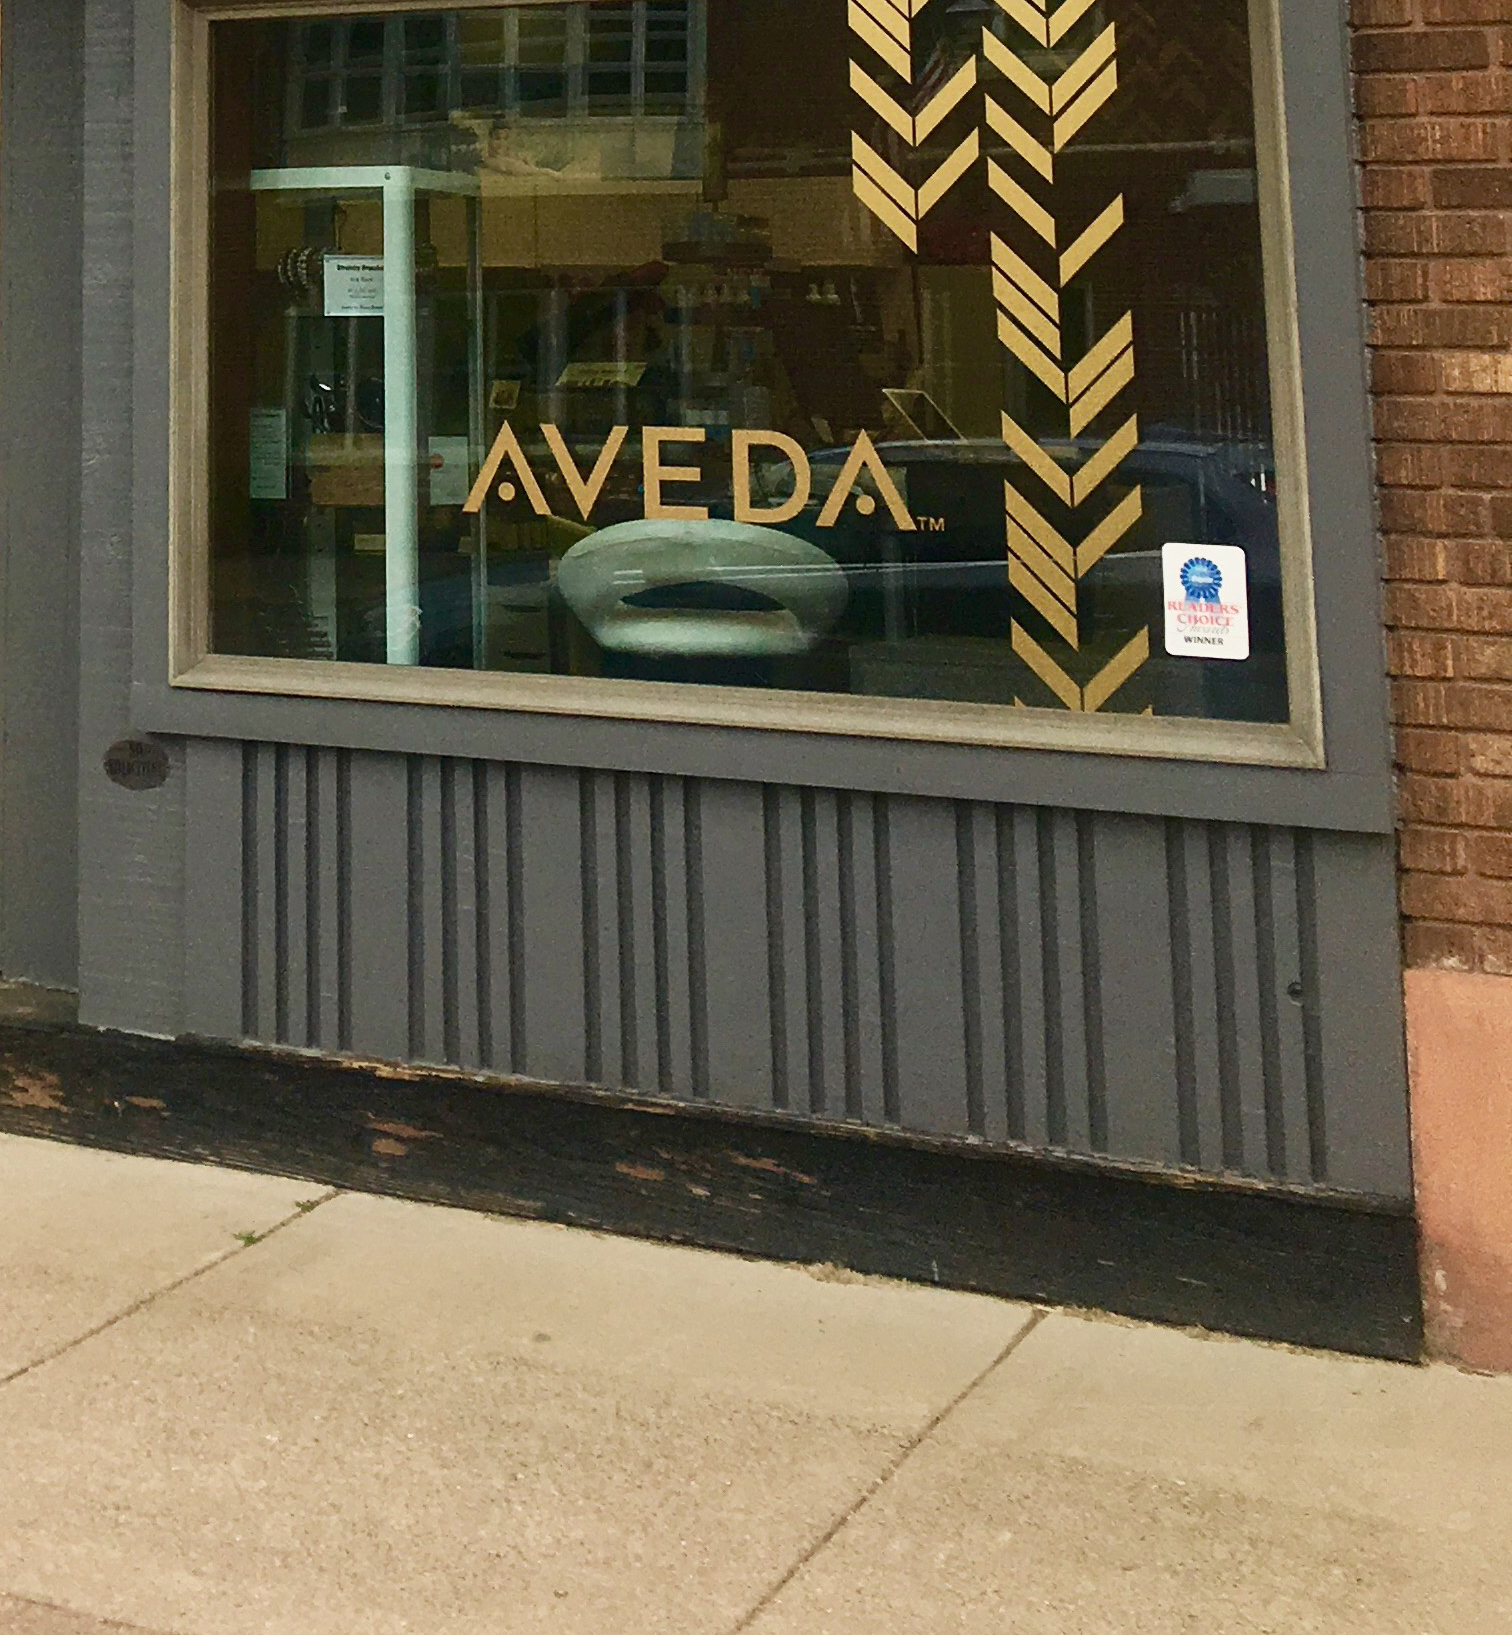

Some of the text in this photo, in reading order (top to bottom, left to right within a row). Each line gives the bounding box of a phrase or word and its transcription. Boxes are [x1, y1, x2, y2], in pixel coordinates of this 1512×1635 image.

[461, 420, 918, 532] AVEDA
[1177, 614, 1234, 626] CHOICE
[1184, 636, 1224, 645] WINNER
